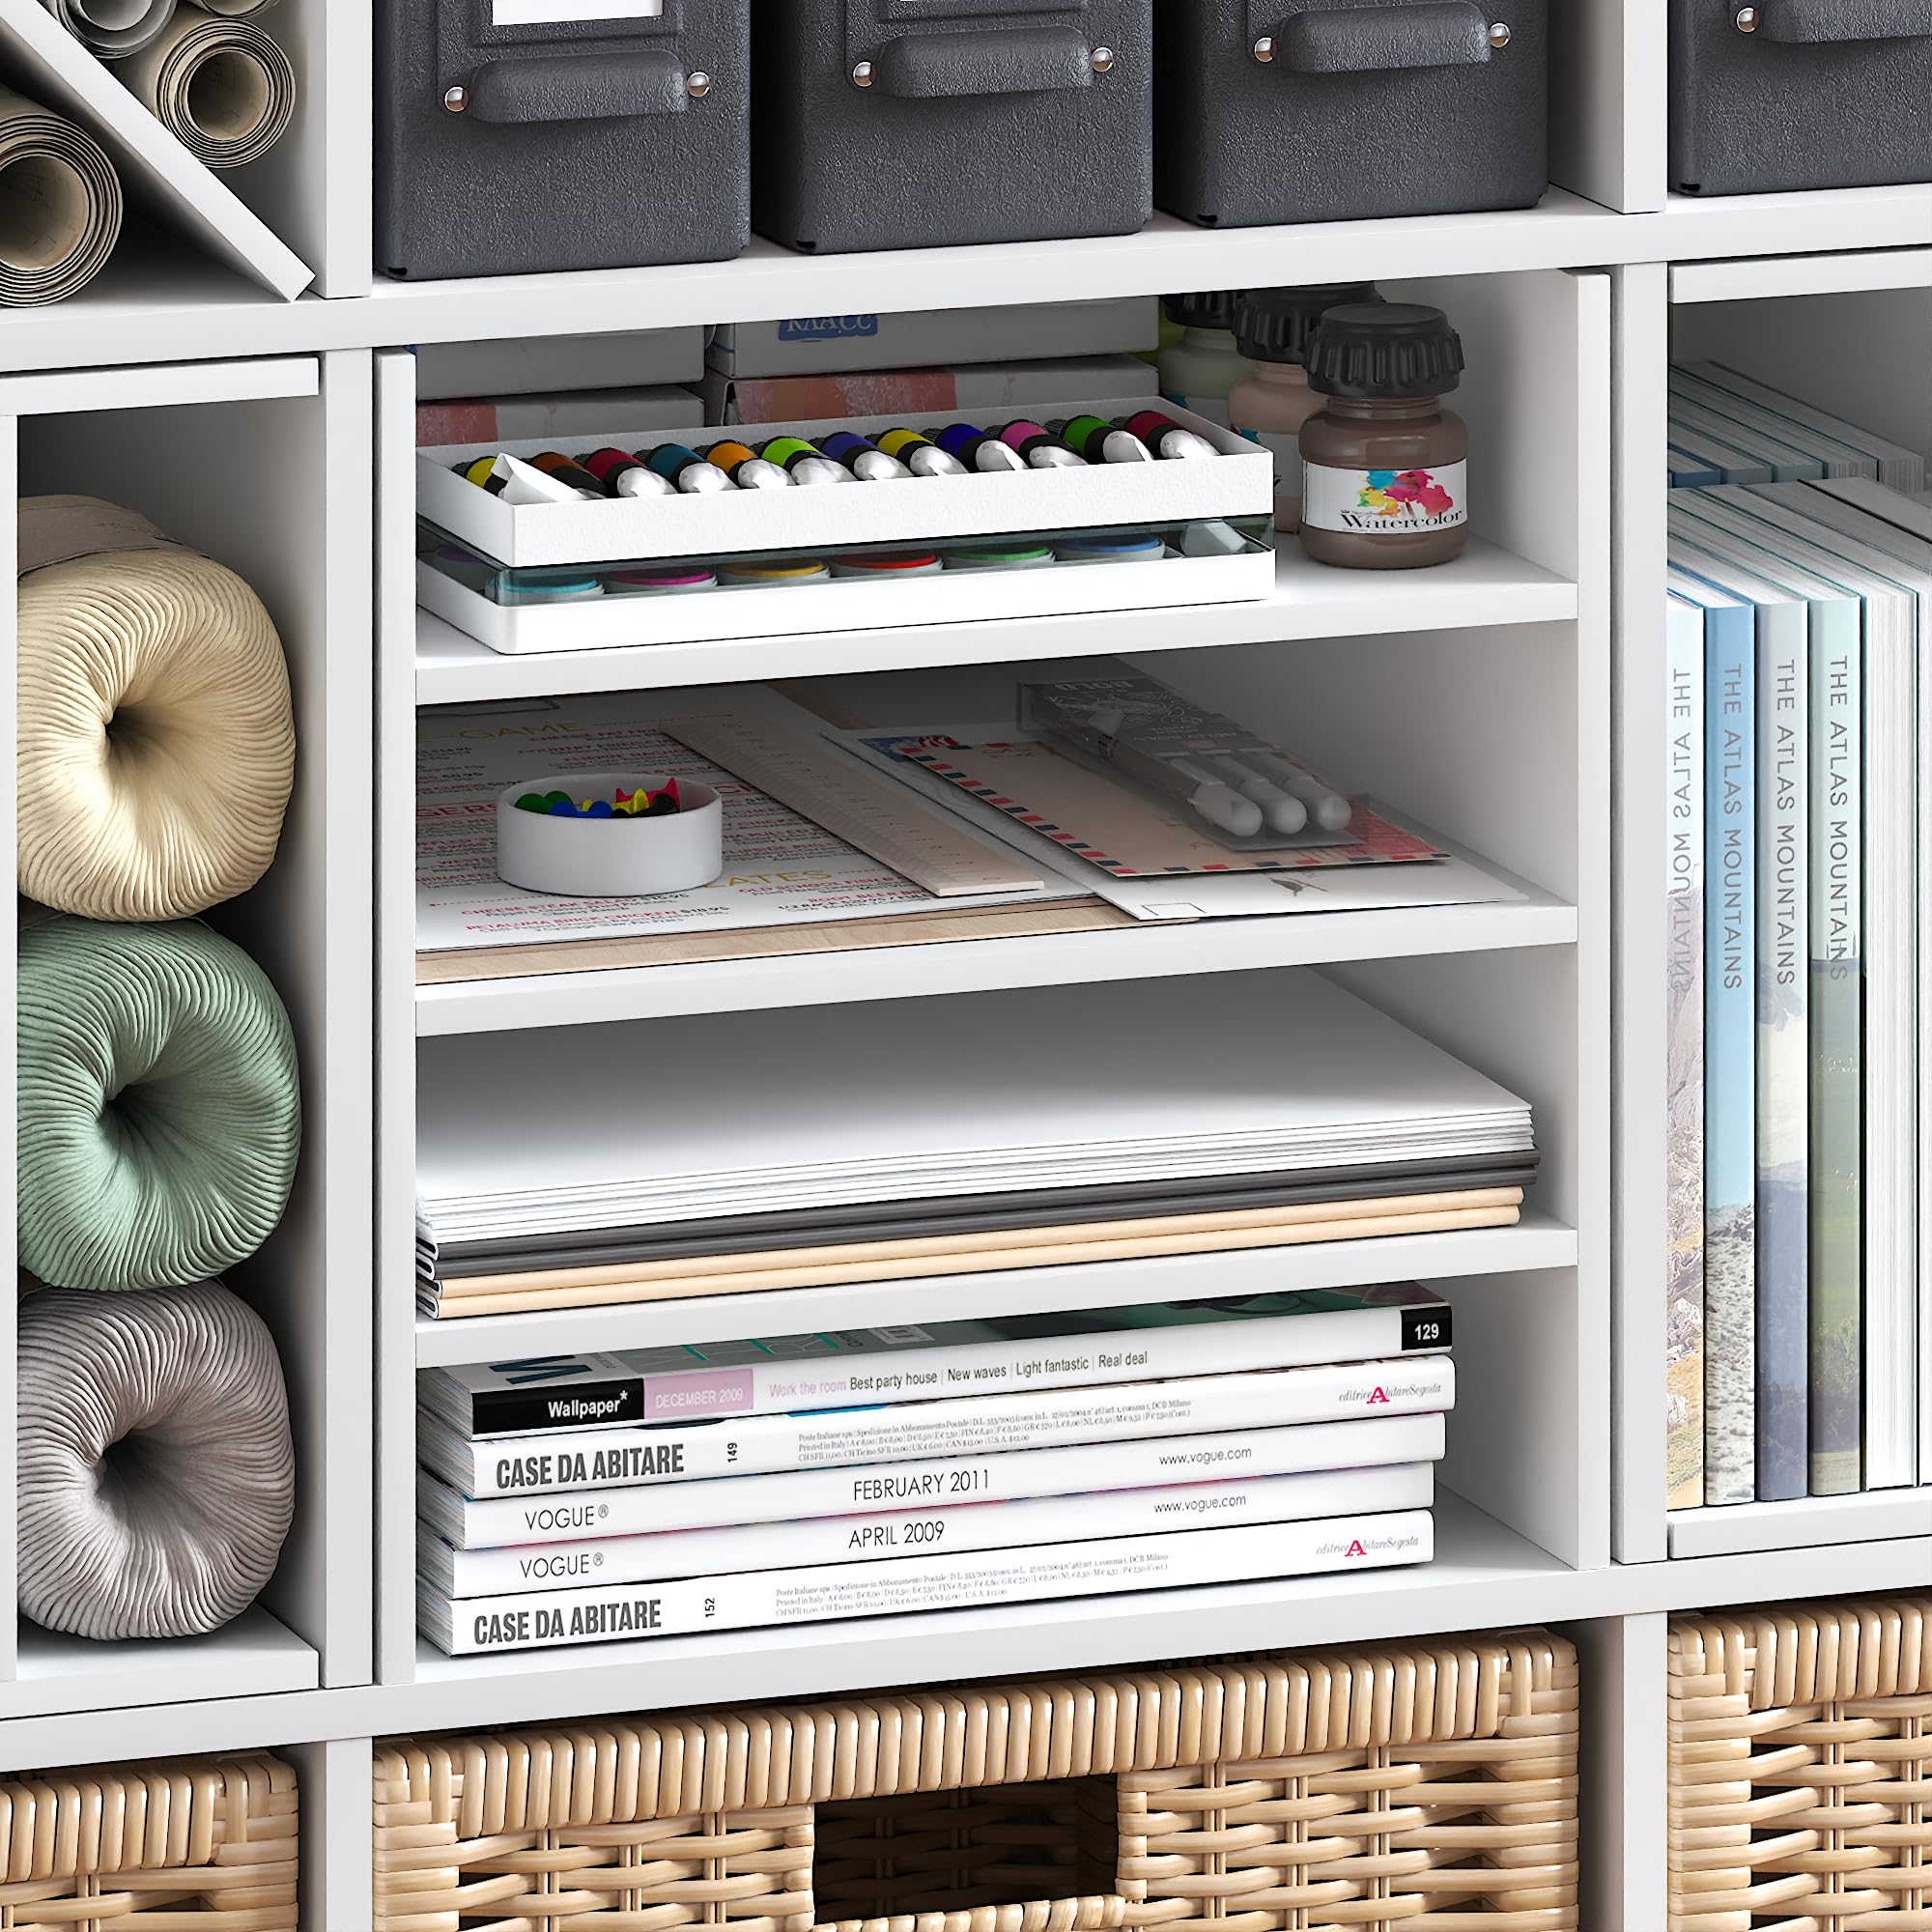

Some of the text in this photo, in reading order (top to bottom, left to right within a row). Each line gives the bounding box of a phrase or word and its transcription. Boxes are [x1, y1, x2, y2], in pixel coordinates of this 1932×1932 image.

[1340, 511, 1463, 529] Watercolor
[1723, 664, 1742, 989] THE ATLAS MOUNTAINS
[1776, 659, 1795, 985] THE ATLAS MOUNTAINS
[1830, 655, 1848, 980] THE ATLAS MOUNTAINS
[1414, 1322, 1439, 1342] 129
[769, 1350, 1148, 1399] Work the room Best party house New waves Light fantastic Real deal
[655, 1386, 745, 1409] DECEMBER 2009
[726, 1441, 739, 1463] 149
[1158, 1446, 1253, 1466] www.vogue.com
[496, 1443, 685, 1490] CASE DA ABITARE
[853, 1468, 990, 1501] FEBRUARY 2011
[1153, 1494, 1247, 1515] www.vogue.com
[848, 1521, 945, 1549] APRIL 2009
[474, 1600, 663, 1646] CASE DA ABITARE
[704, 1598, 716, 1620] 152
